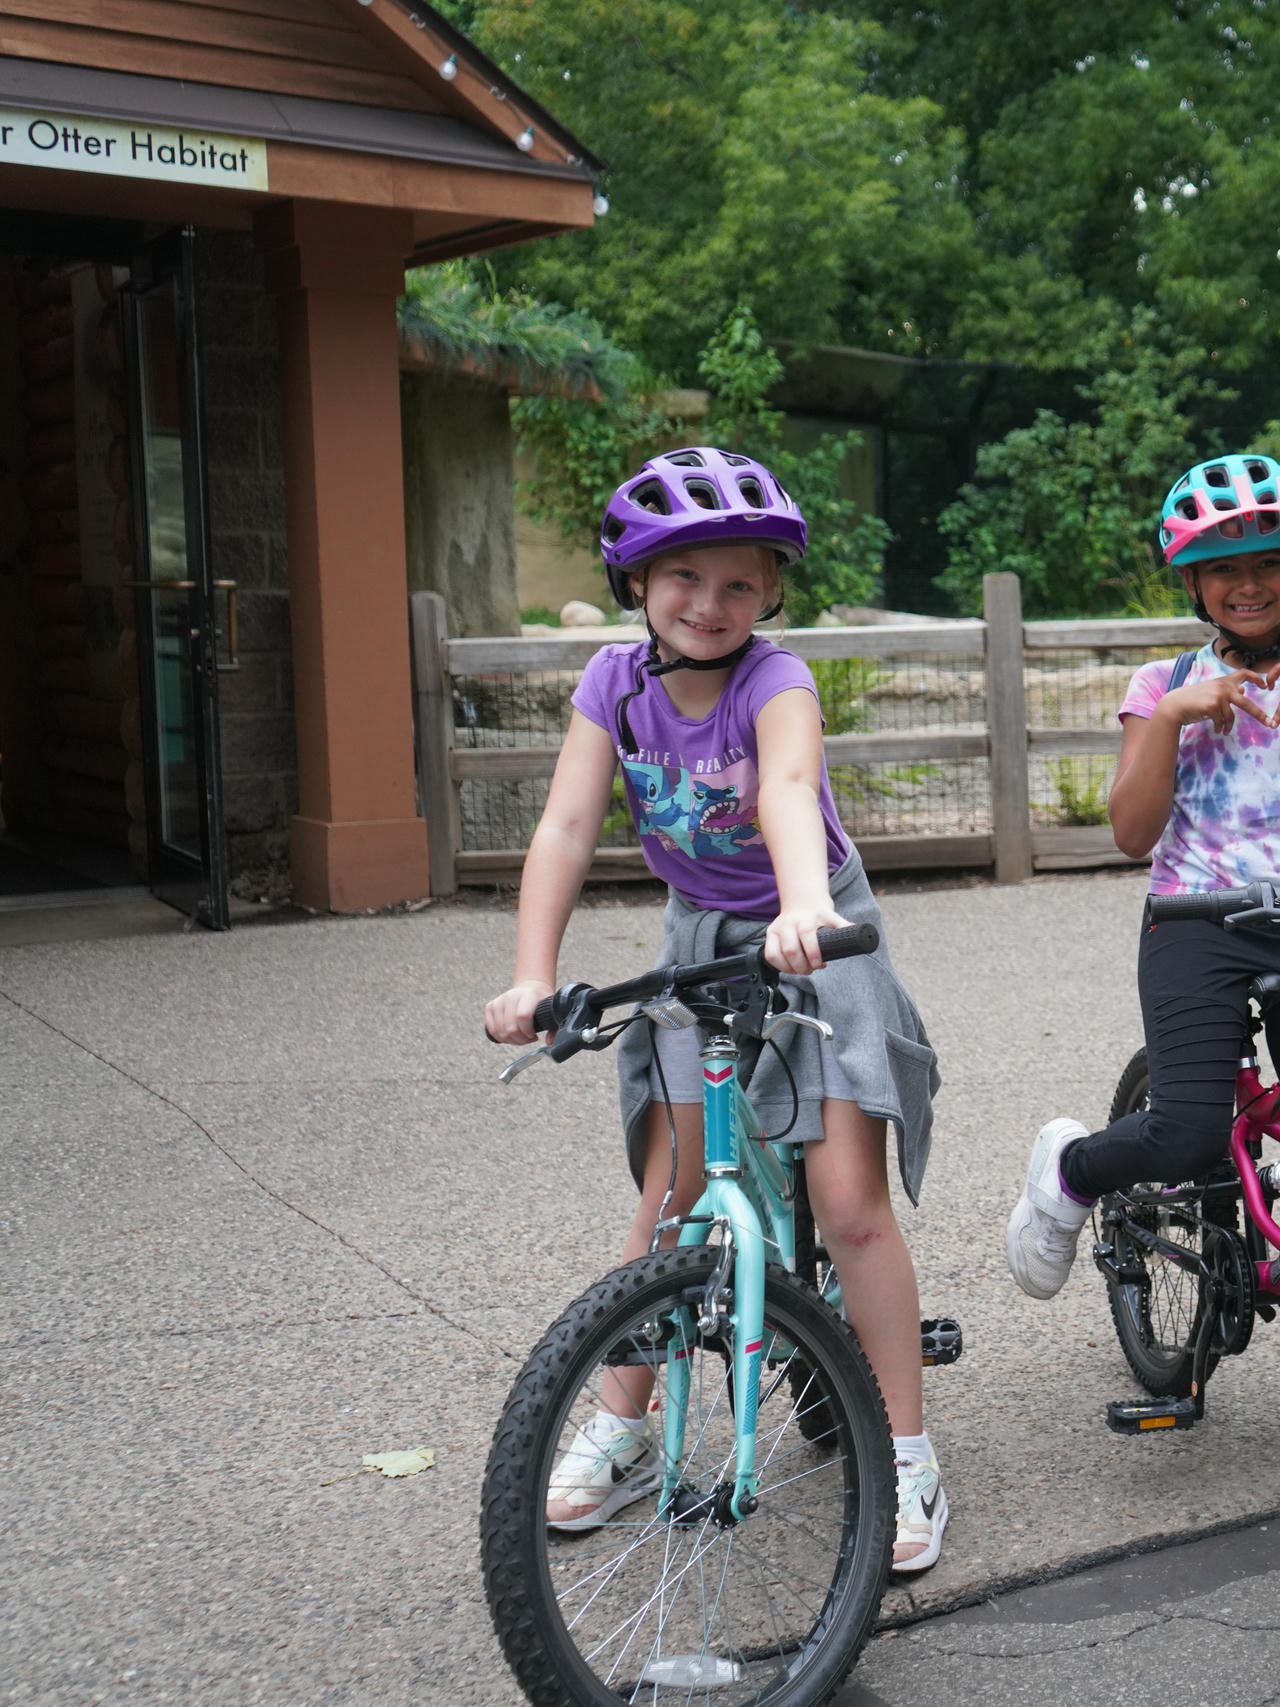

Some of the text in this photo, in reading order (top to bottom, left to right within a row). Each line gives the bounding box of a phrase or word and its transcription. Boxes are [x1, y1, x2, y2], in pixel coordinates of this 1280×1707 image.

[27, 119, 117, 157] Otter
[130, 131, 249, 173] Habitat
[695, 745, 747, 774] REAITY
